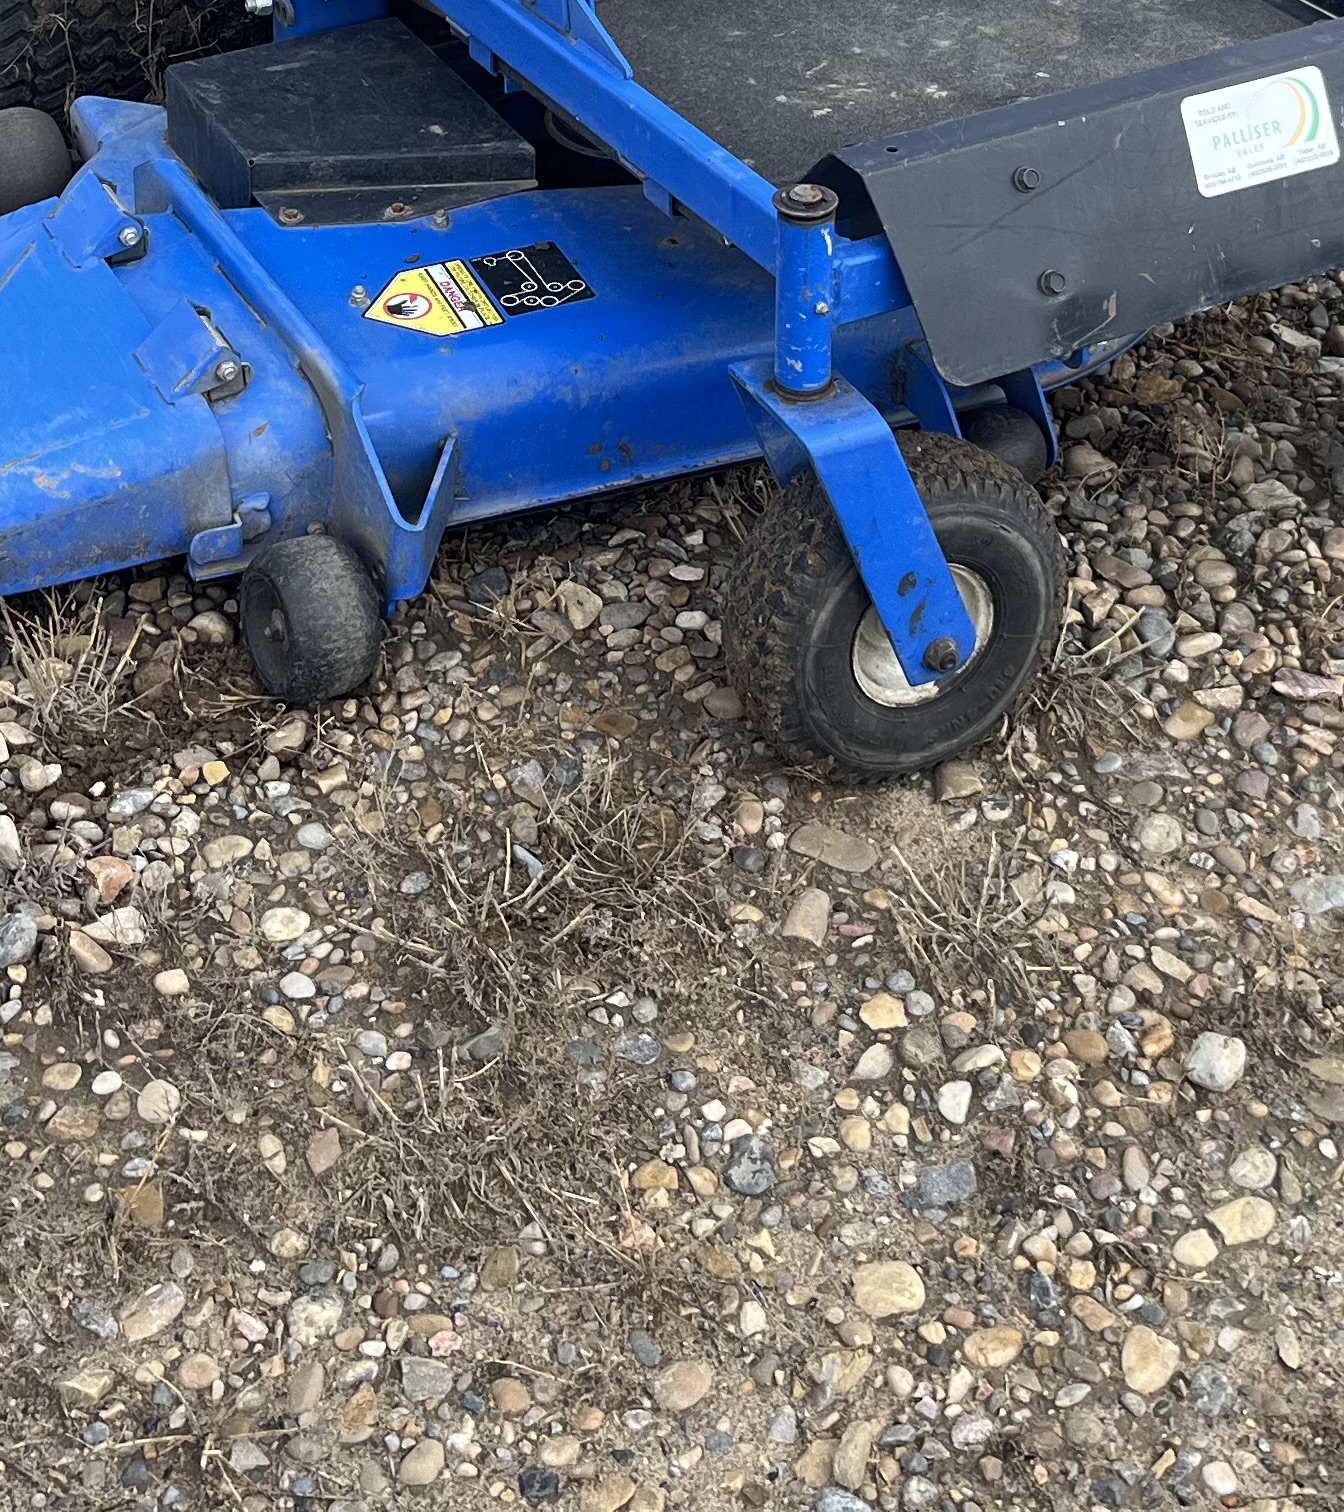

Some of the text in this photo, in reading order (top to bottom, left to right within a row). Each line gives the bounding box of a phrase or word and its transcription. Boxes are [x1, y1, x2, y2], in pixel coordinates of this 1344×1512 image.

[1217, 103, 1231, 111] AND
[1195, 114, 1226, 127] SERVICED
[1212, 120, 1281, 150] PALLISER
[1236, 143, 1264, 157] SALES
